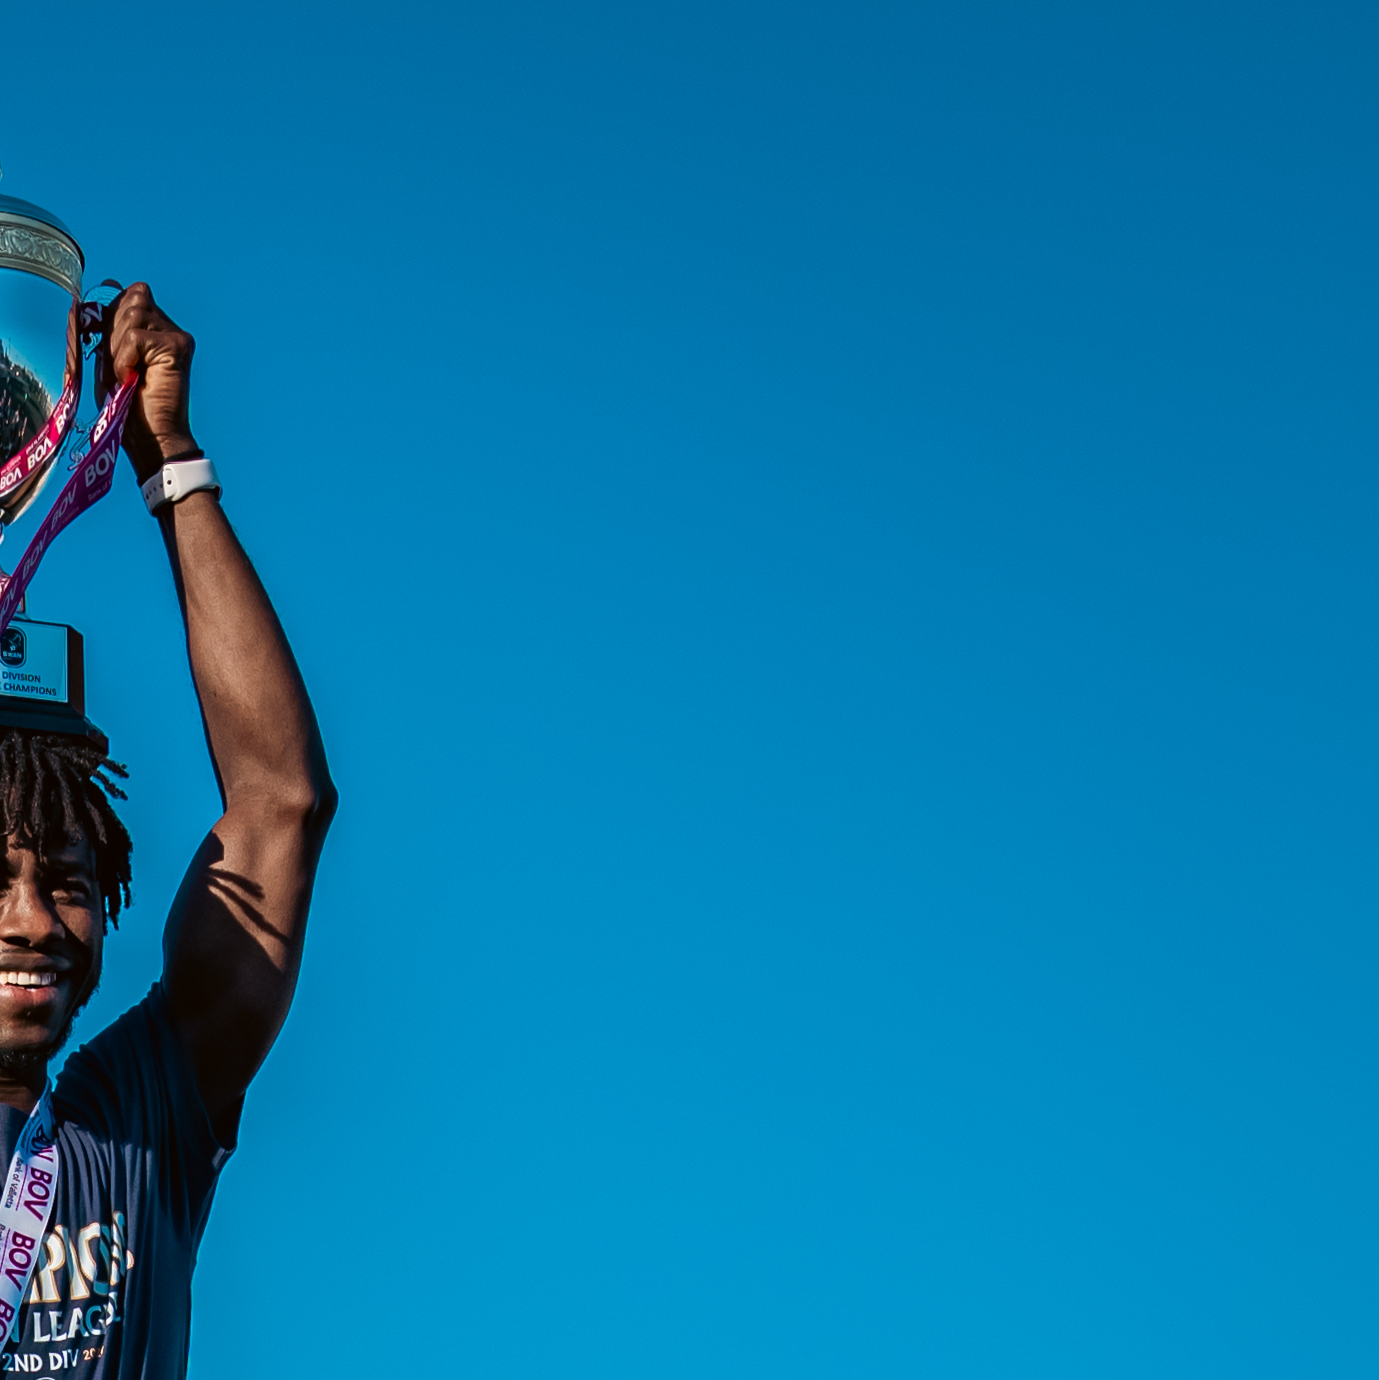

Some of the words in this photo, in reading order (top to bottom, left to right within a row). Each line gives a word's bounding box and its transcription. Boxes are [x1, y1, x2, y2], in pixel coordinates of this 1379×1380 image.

[84, 439, 116, 487] BOV
[3, 671, 41, 683] DIVISION
[4, 682, 57, 696] CHAMPIONS
[24, 1166, 53, 1222] BOV
[5, 1230, 36, 1292] BOV
[2, 1353, 43, 1372] 2ND
[49, 1348, 79, 1371] DIV
